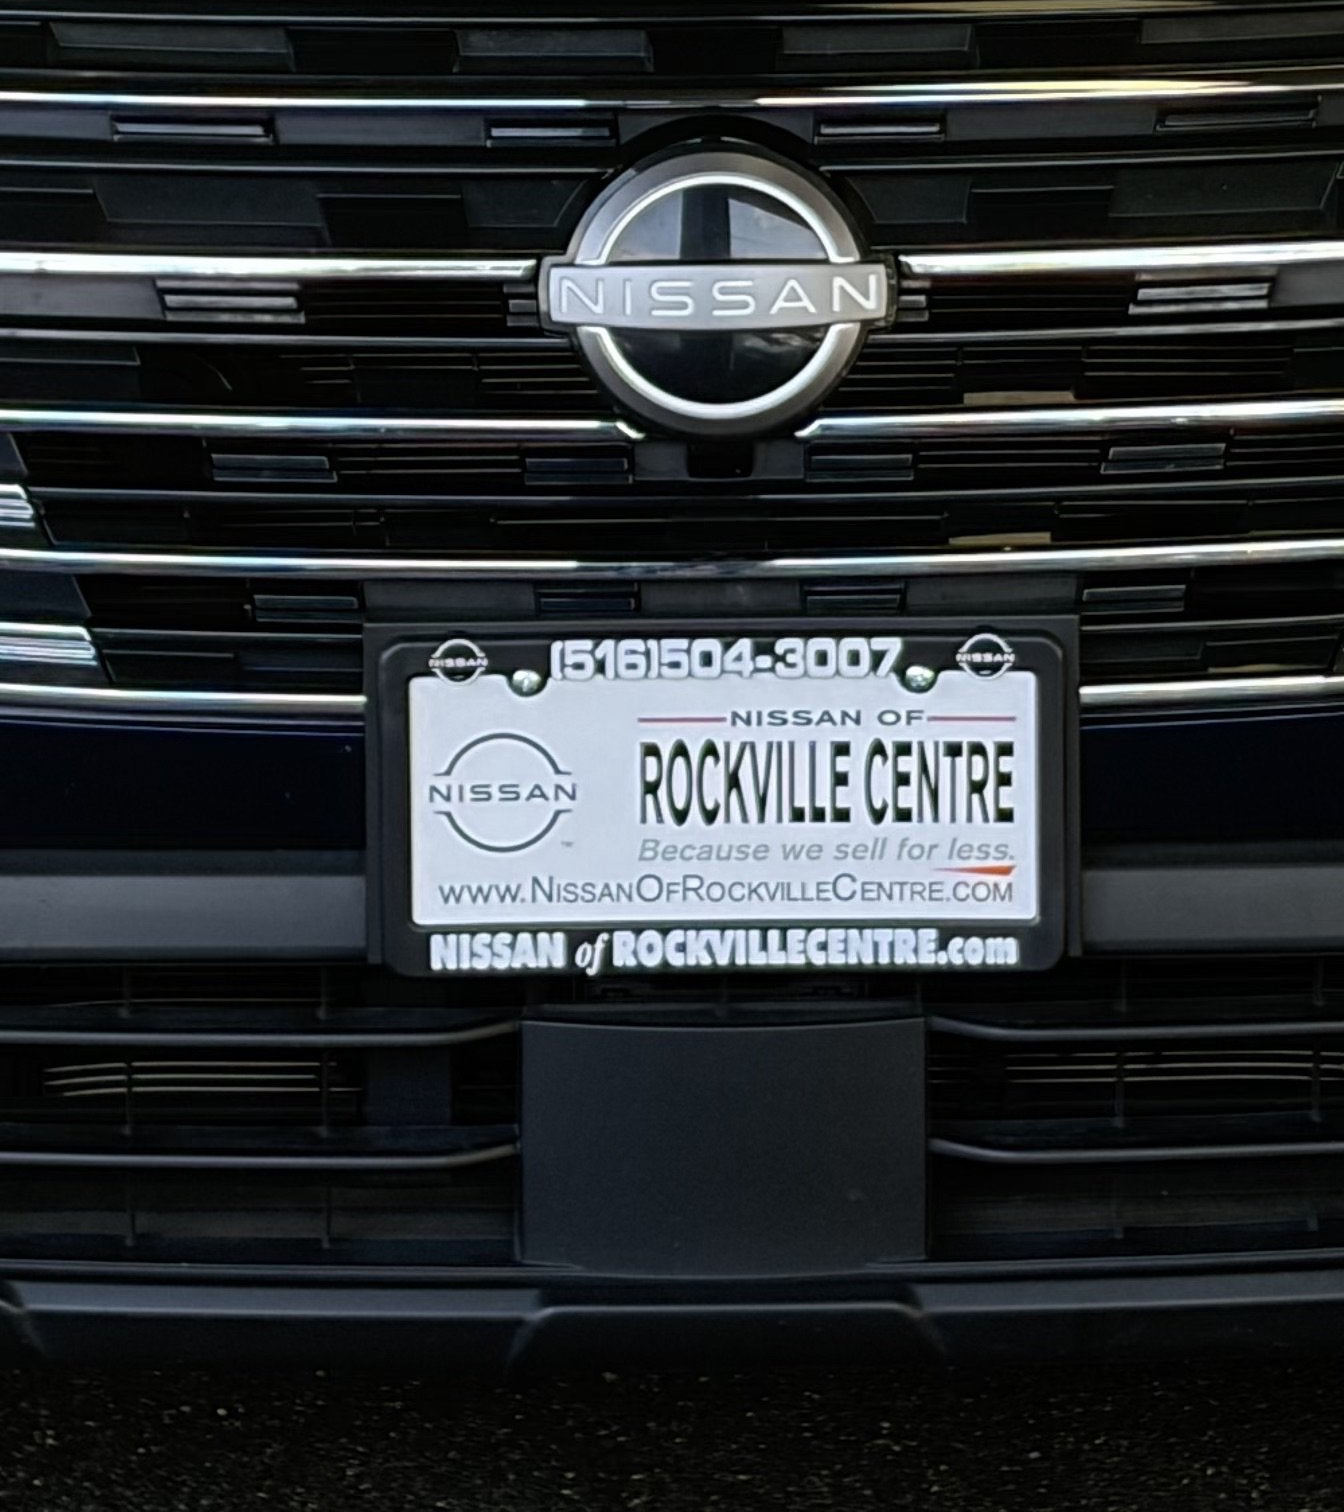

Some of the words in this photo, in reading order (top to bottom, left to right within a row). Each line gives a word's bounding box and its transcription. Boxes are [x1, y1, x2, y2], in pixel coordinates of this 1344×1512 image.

[558, 273, 879, 317] NISSAN
[428, 657, 489, 669] NISSAN
[550, 637, 903, 680] (516)504-3007
[955, 652, 1016, 664] NISSAN
[730, 710, 862, 727] NISSAN
[877, 709, 925, 727] OF
[428, 783, 578, 804] NISSAN
[638, 738, 852, 827] ROCKVILLE
[863, 737, 1016, 826] CENTRE
[637, 838, 770, 862] Because
[781, 844, 824, 861] we
[832, 837, 887, 861] sell
[896, 837, 939, 861] for
[947, 837, 1016, 861] less.
[430, 932, 567, 971] NISSAN
[574, 933, 610, 977] of
[611, 928, 1021, 966] ROCKVILLECENTRE.com
